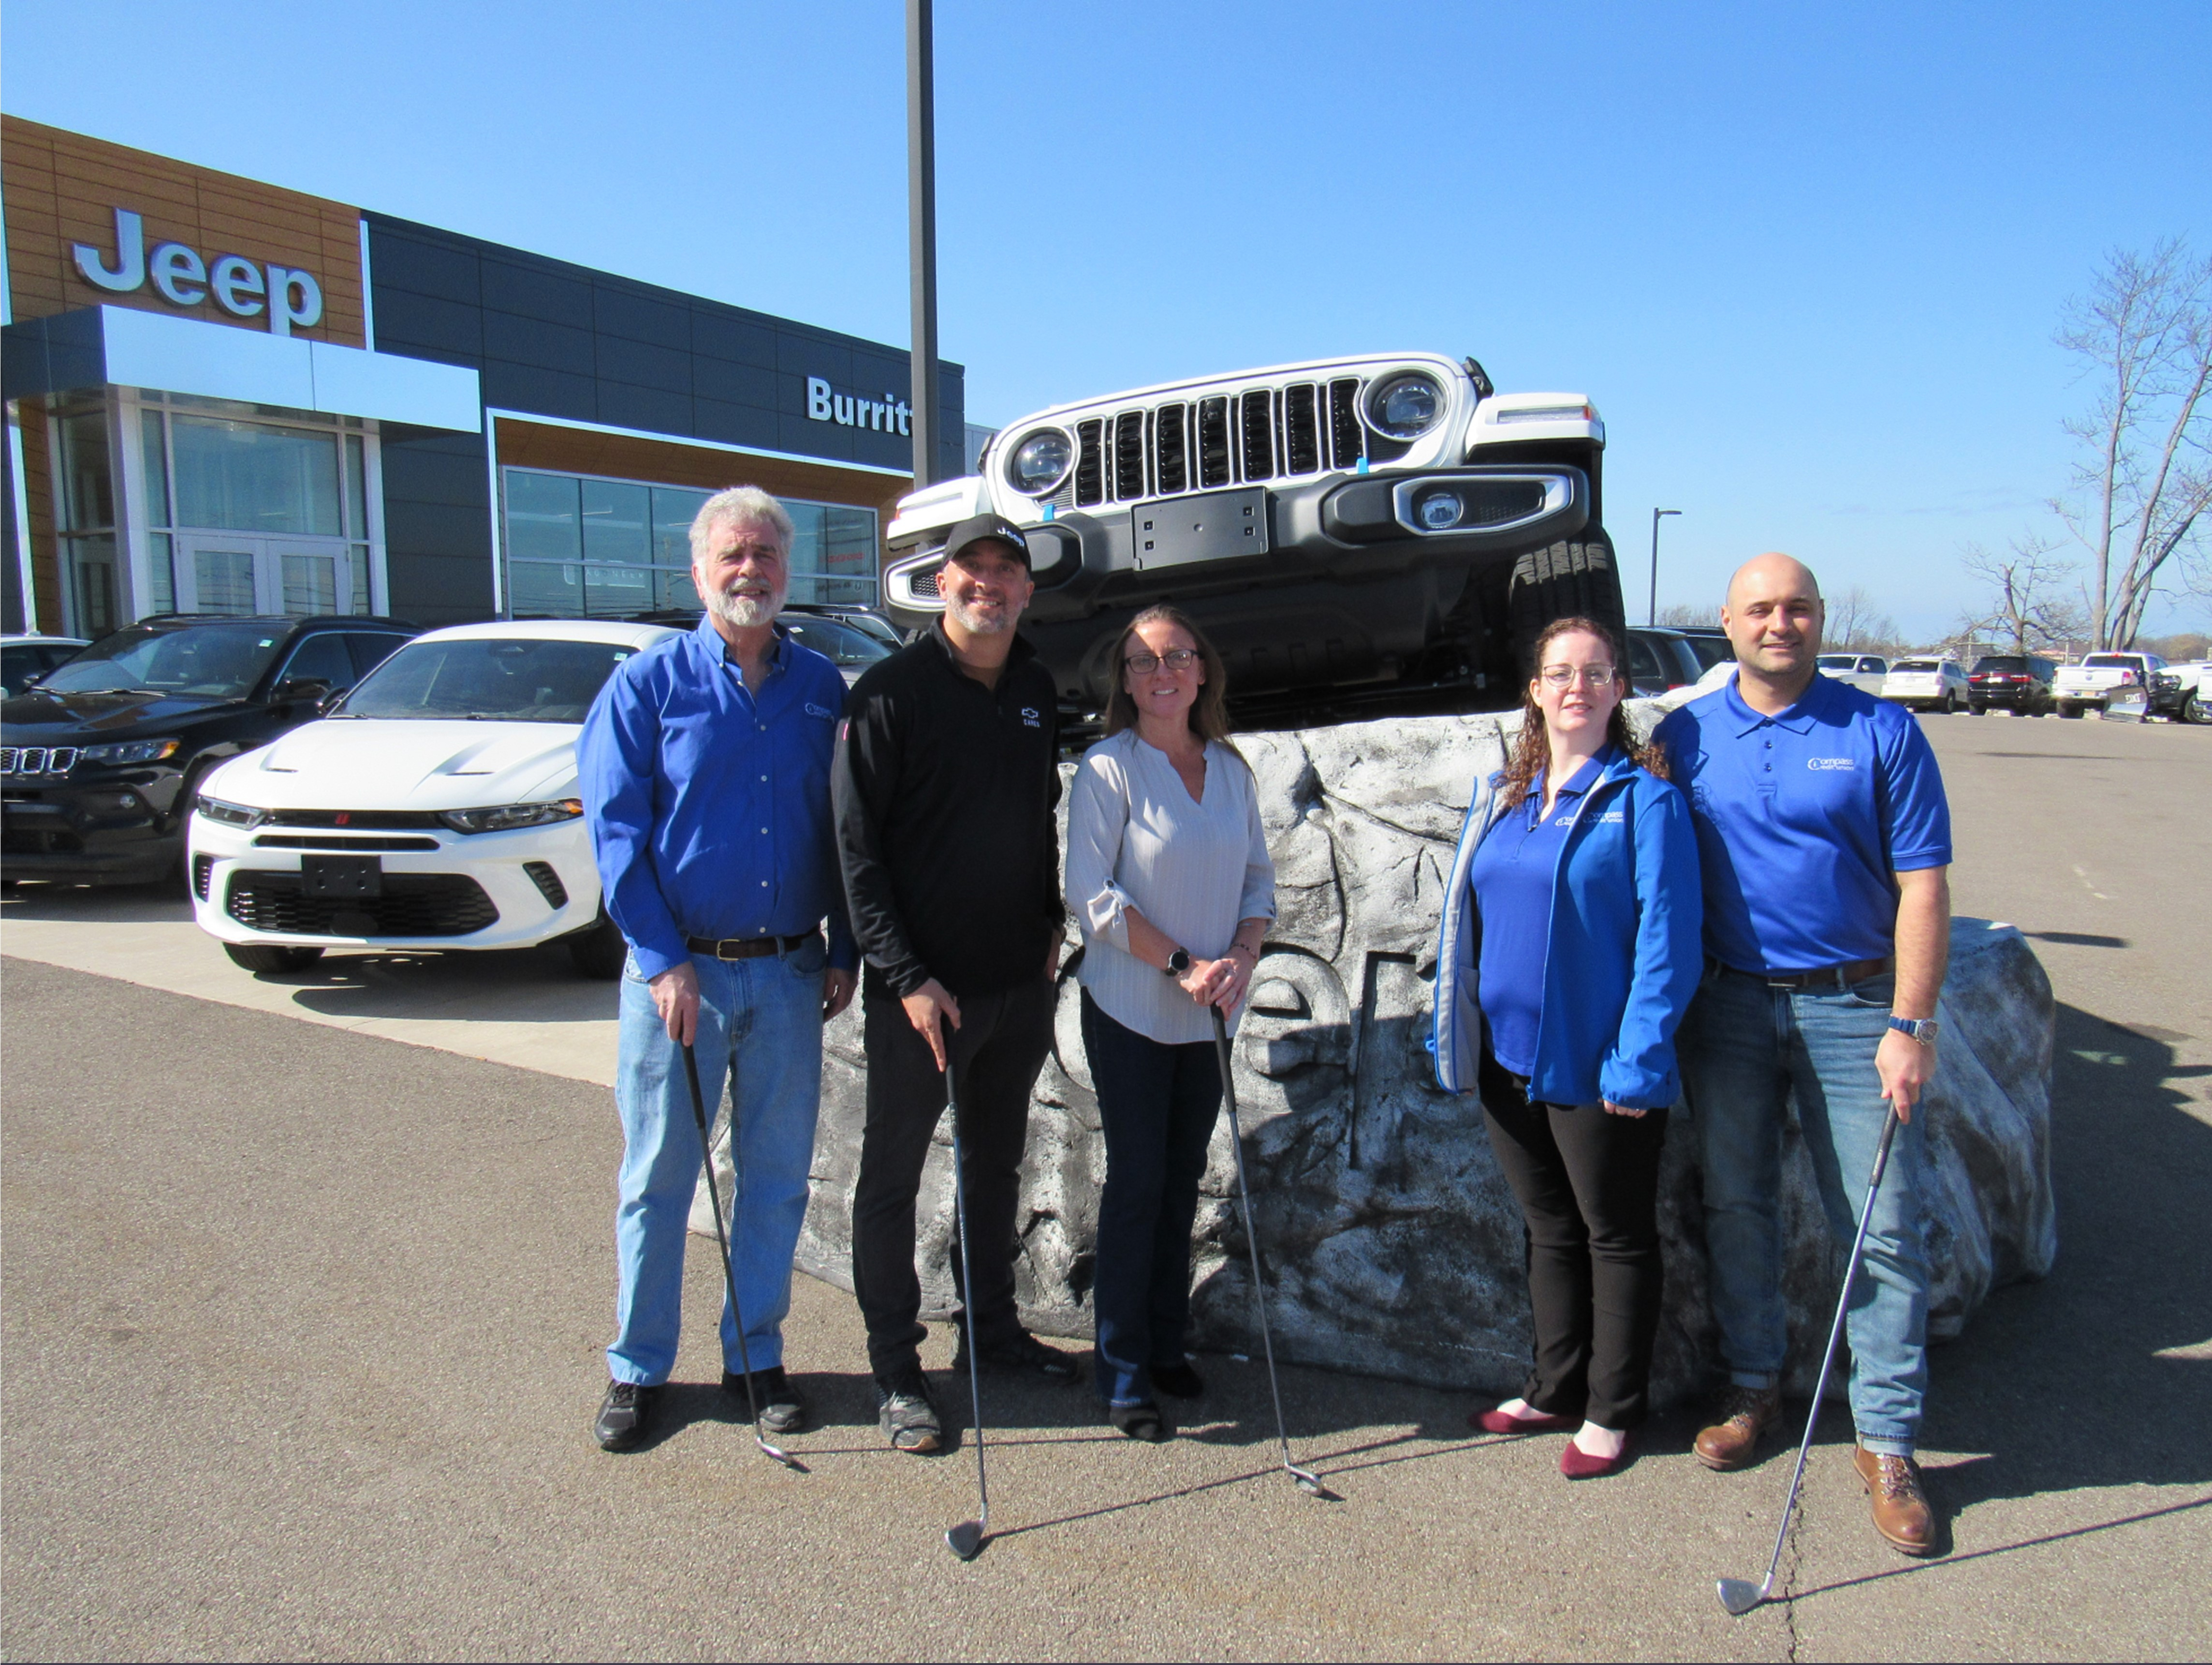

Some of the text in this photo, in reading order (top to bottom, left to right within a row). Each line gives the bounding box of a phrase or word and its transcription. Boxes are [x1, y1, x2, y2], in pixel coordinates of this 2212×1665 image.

[73, 207, 323, 338] Jeep
[807, 375, 913, 436] Burrit
[997, 526, 1025, 549] Jeep
[1807, 758, 1854, 770] Compass
